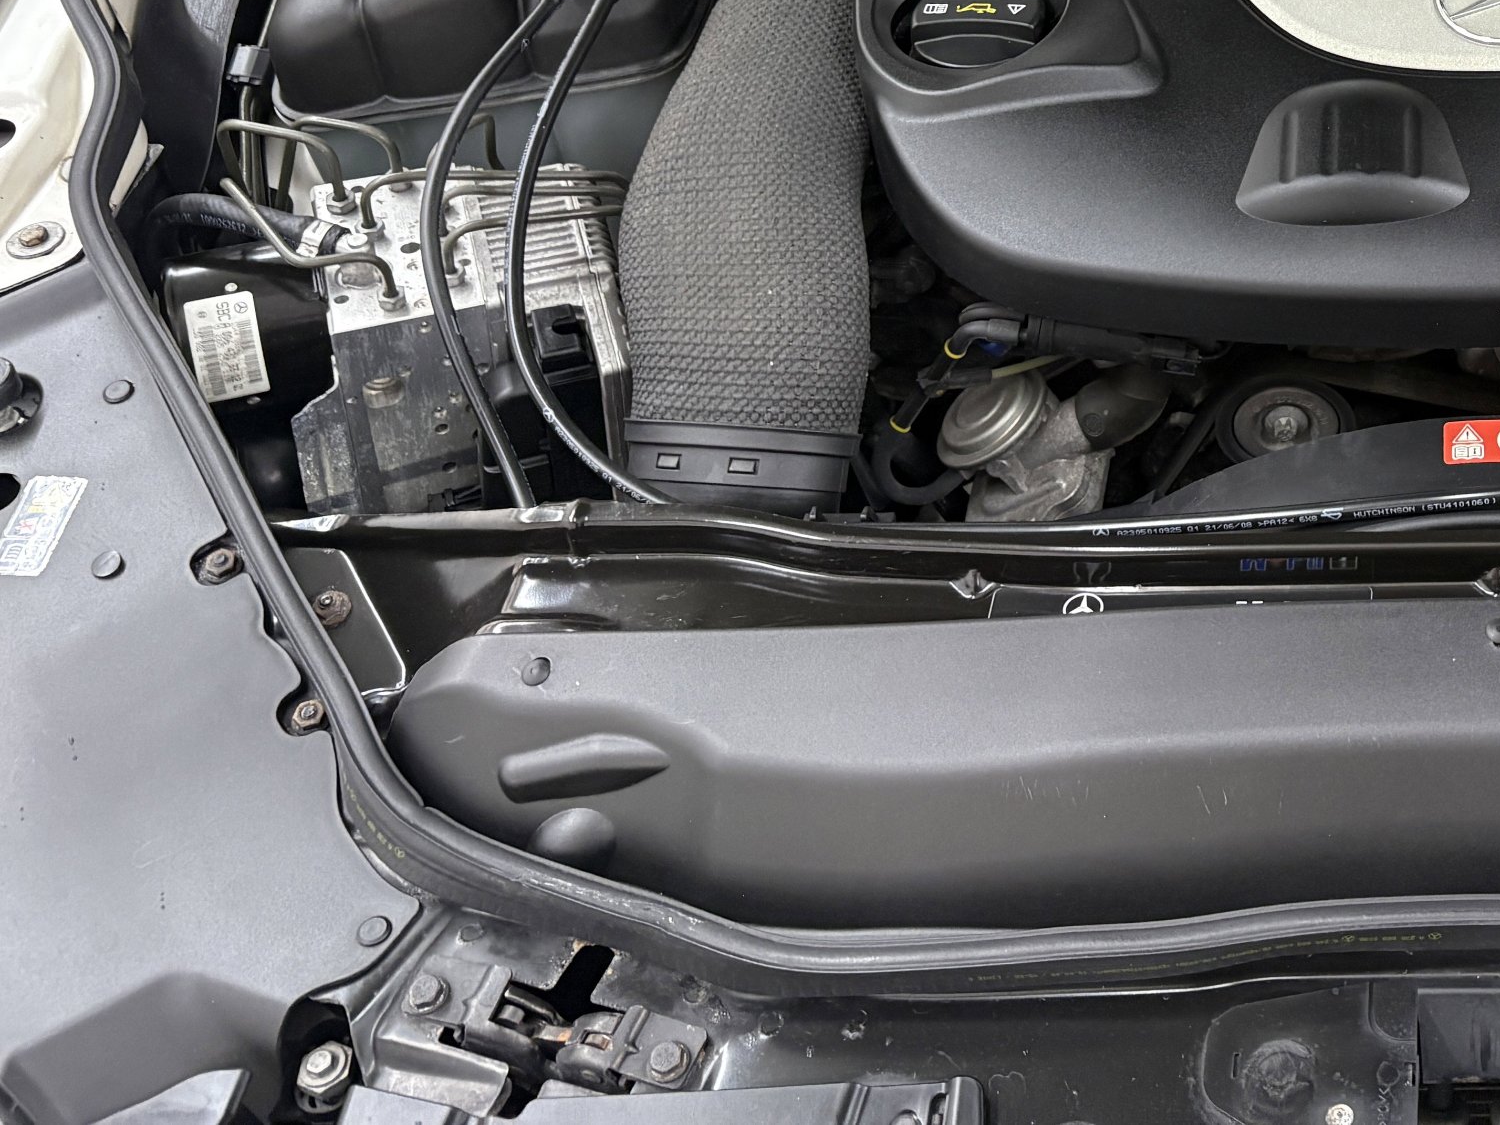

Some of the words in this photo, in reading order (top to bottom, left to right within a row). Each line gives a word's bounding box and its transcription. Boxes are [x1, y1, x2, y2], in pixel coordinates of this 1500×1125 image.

[216, 301, 231, 321] SBC
[1116, 526, 1182, 537] A2305010925
[1205, 521, 1252, 532] 21/06/08
[1299, 514, 1318, 523] 6X8
[1353, 505, 1416, 519] HUTCHINSON
[1421, 496, 1496, 512] (STU4101060)
